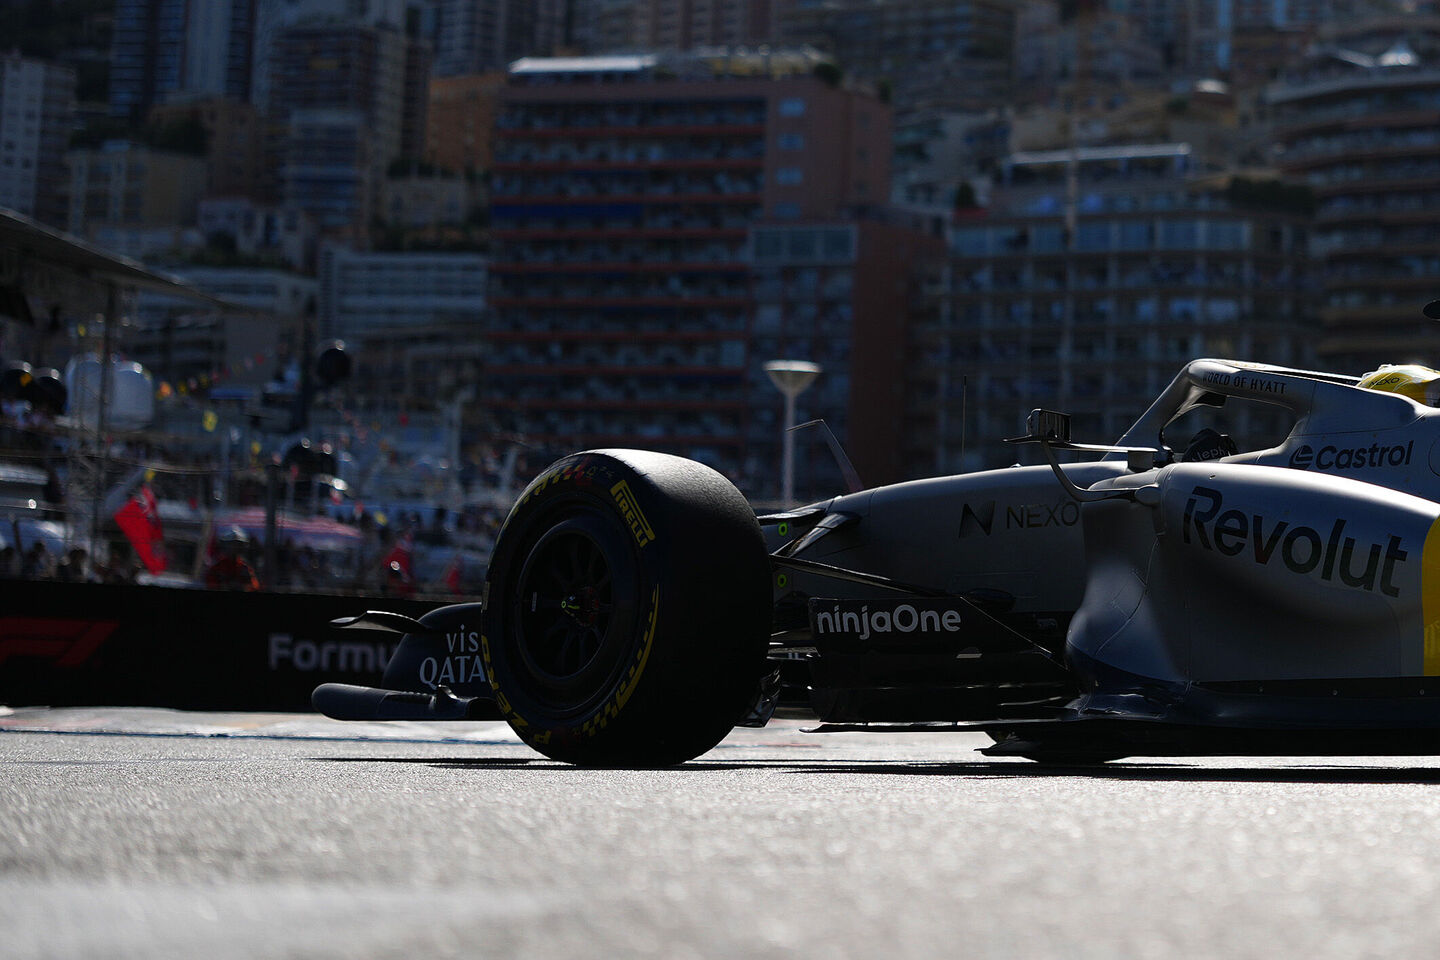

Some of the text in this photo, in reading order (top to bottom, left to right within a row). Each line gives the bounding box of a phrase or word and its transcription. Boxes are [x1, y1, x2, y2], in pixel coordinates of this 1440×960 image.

[1233, 376, 1248, 387] OF
[1250, 379, 1287, 394] HYATT
[1315, 440, 1414, 469] Castrol
[609, 479, 656, 548] PIRELLI
[1006, 501, 1080, 529] NEXO
[1183, 486, 1408, 598] Revolut
[816, 604, 962, 640] ninjaOne
[446, 624, 480, 653] vis
[419, 655, 486, 690] QATA
